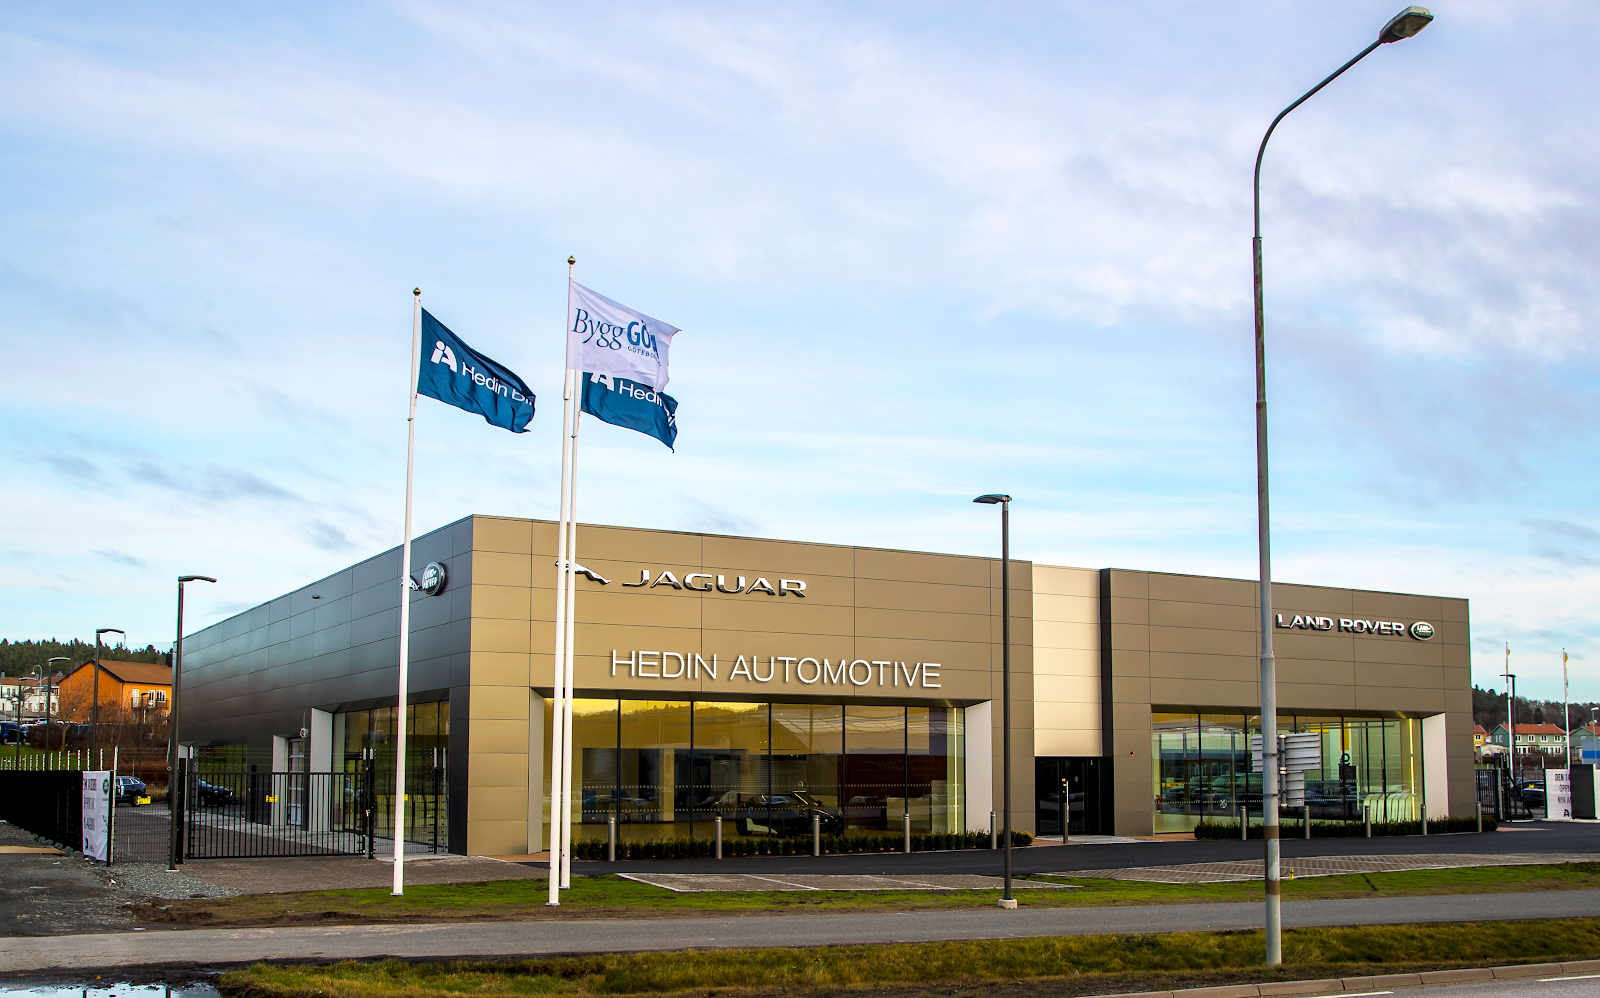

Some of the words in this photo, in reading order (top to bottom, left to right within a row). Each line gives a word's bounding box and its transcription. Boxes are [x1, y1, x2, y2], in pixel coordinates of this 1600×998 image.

[571, 307, 625, 351] Bygg
[462, 361, 508, 398] Hedin
[622, 569, 807, 598] JAGUAR
[1276, 613, 1334, 631] LAND
[1338, 617, 1405, 637] ROVER
[611, 649, 717, 680] HEDIN
[729, 654, 942, 688] AUTOMOTIVE
